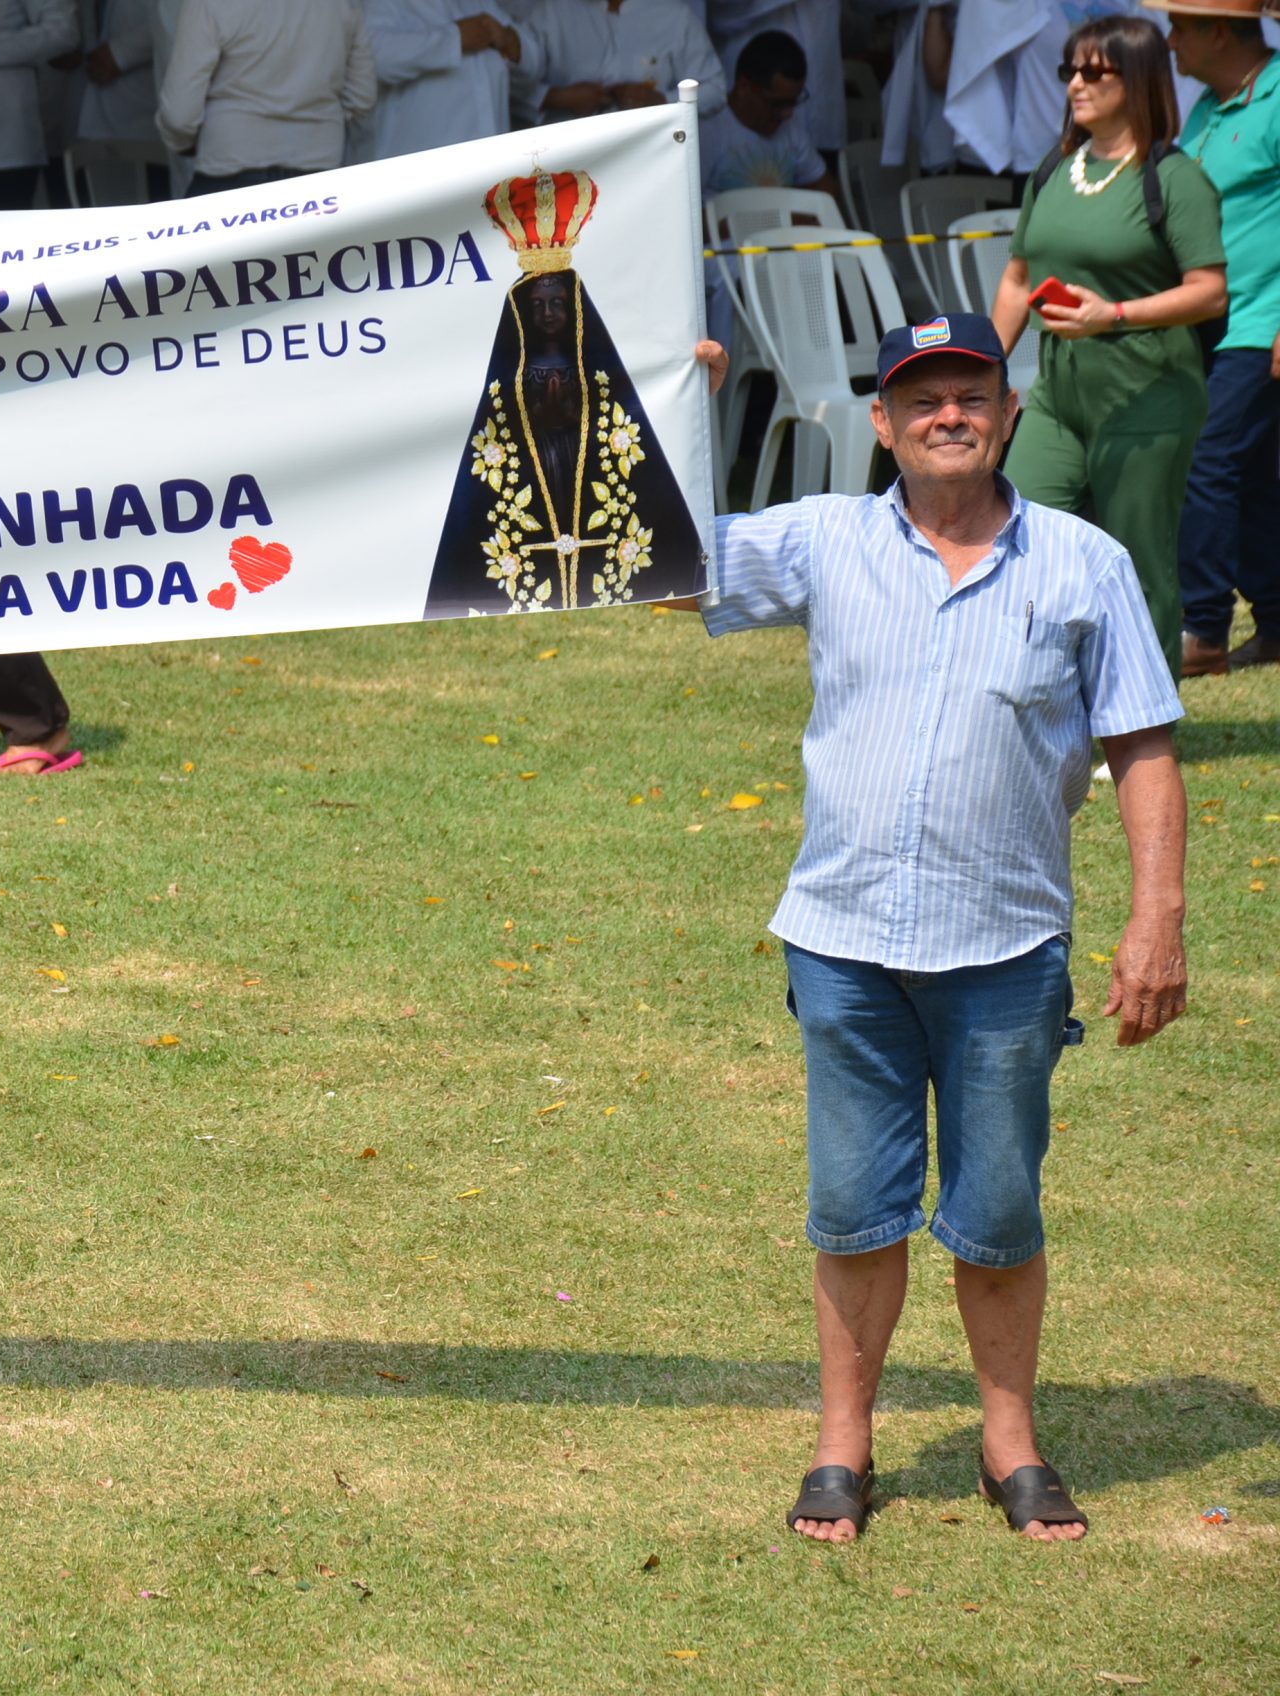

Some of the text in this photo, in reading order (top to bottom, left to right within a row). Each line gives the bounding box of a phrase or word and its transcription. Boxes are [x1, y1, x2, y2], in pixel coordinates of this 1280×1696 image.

[32, 236, 120, 260] JESUS
[146, 220, 212, 241] VILA
[220, 196, 340, 230] VARGAS
[91, 229, 493, 324] APARECIDA
[151, 331, 222, 372] DE
[242, 316, 388, 365] DEUS
[46, 560, 199, 613] VIDA
